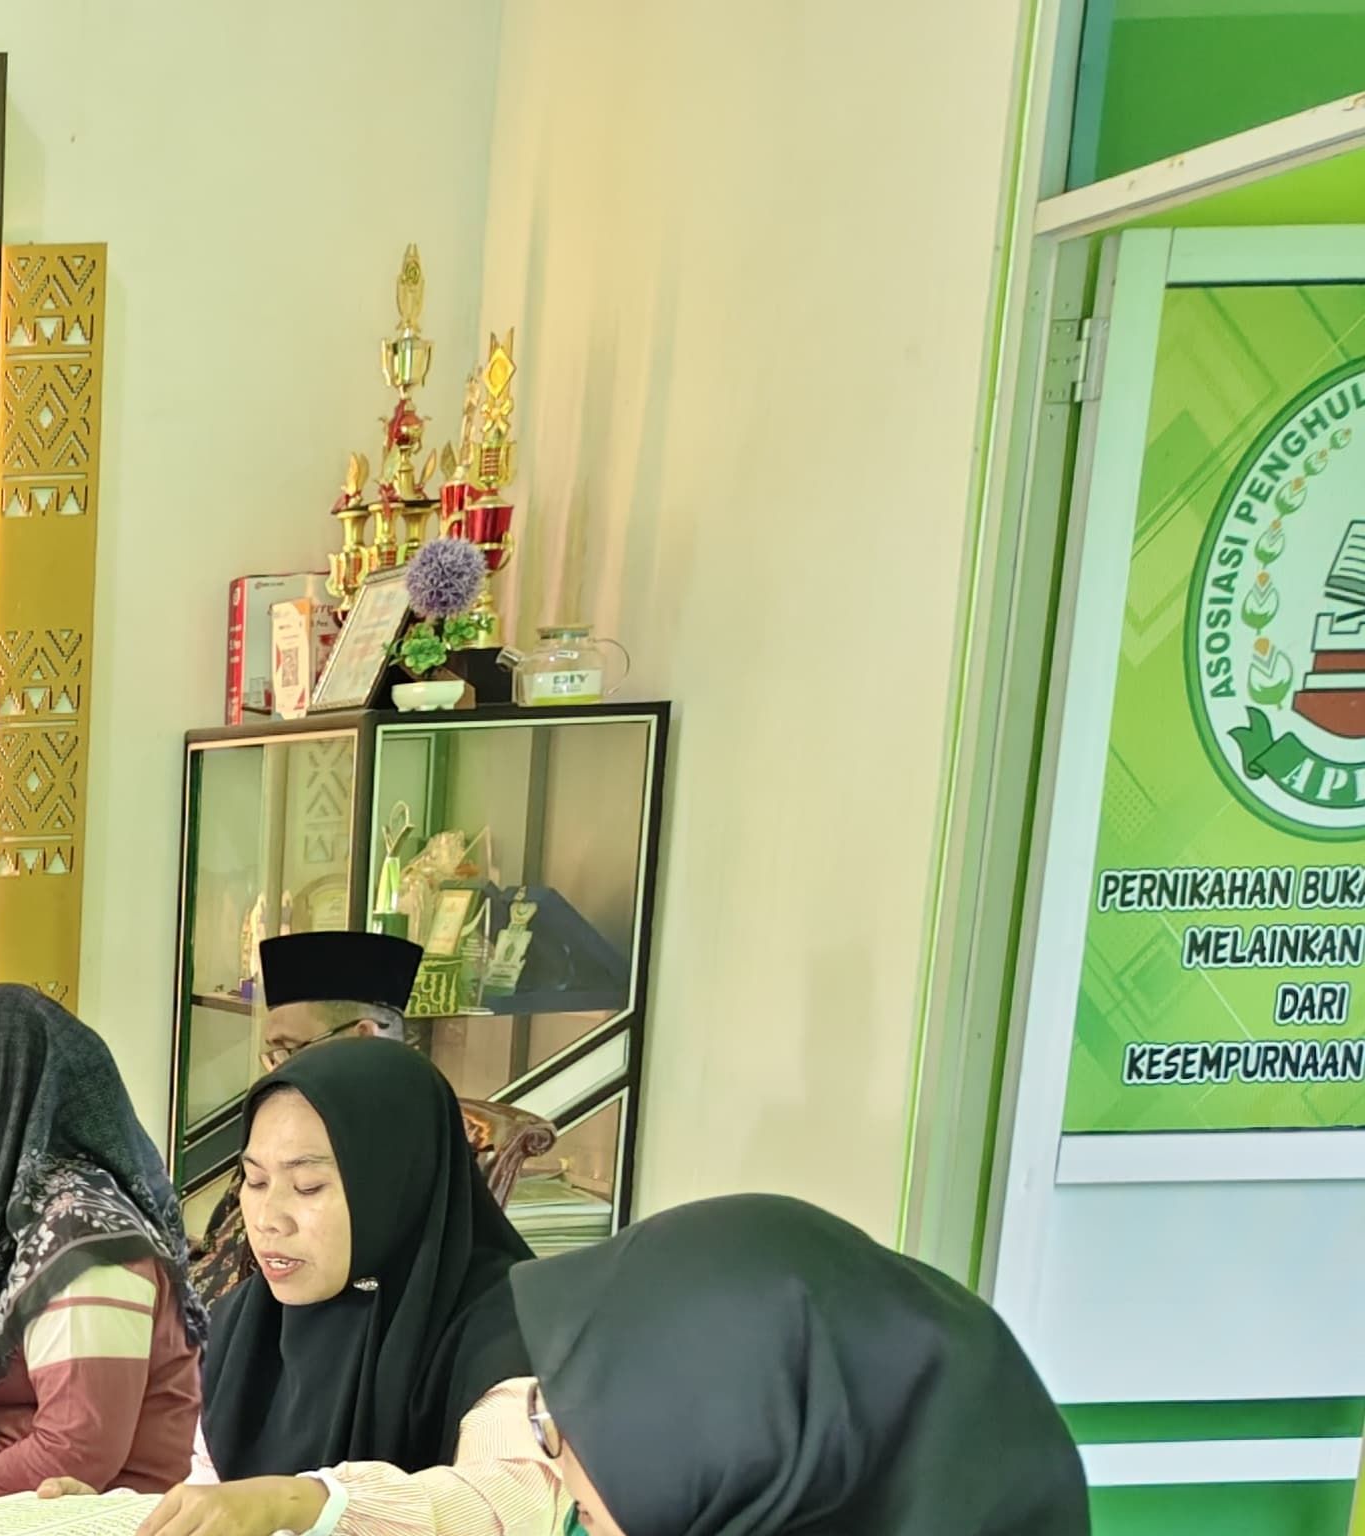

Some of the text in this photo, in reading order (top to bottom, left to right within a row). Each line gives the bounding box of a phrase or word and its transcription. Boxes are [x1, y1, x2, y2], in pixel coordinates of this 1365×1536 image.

[1206, 535, 1249, 699] ASOSIASI
[1100, 869, 1293, 909] PERNIKAHAN
[1185, 927, 1363, 965] MELAINKAN
[1277, 986, 1347, 1021] DARI
[1126, 1044, 1365, 1082] KESEMPURNAAN
